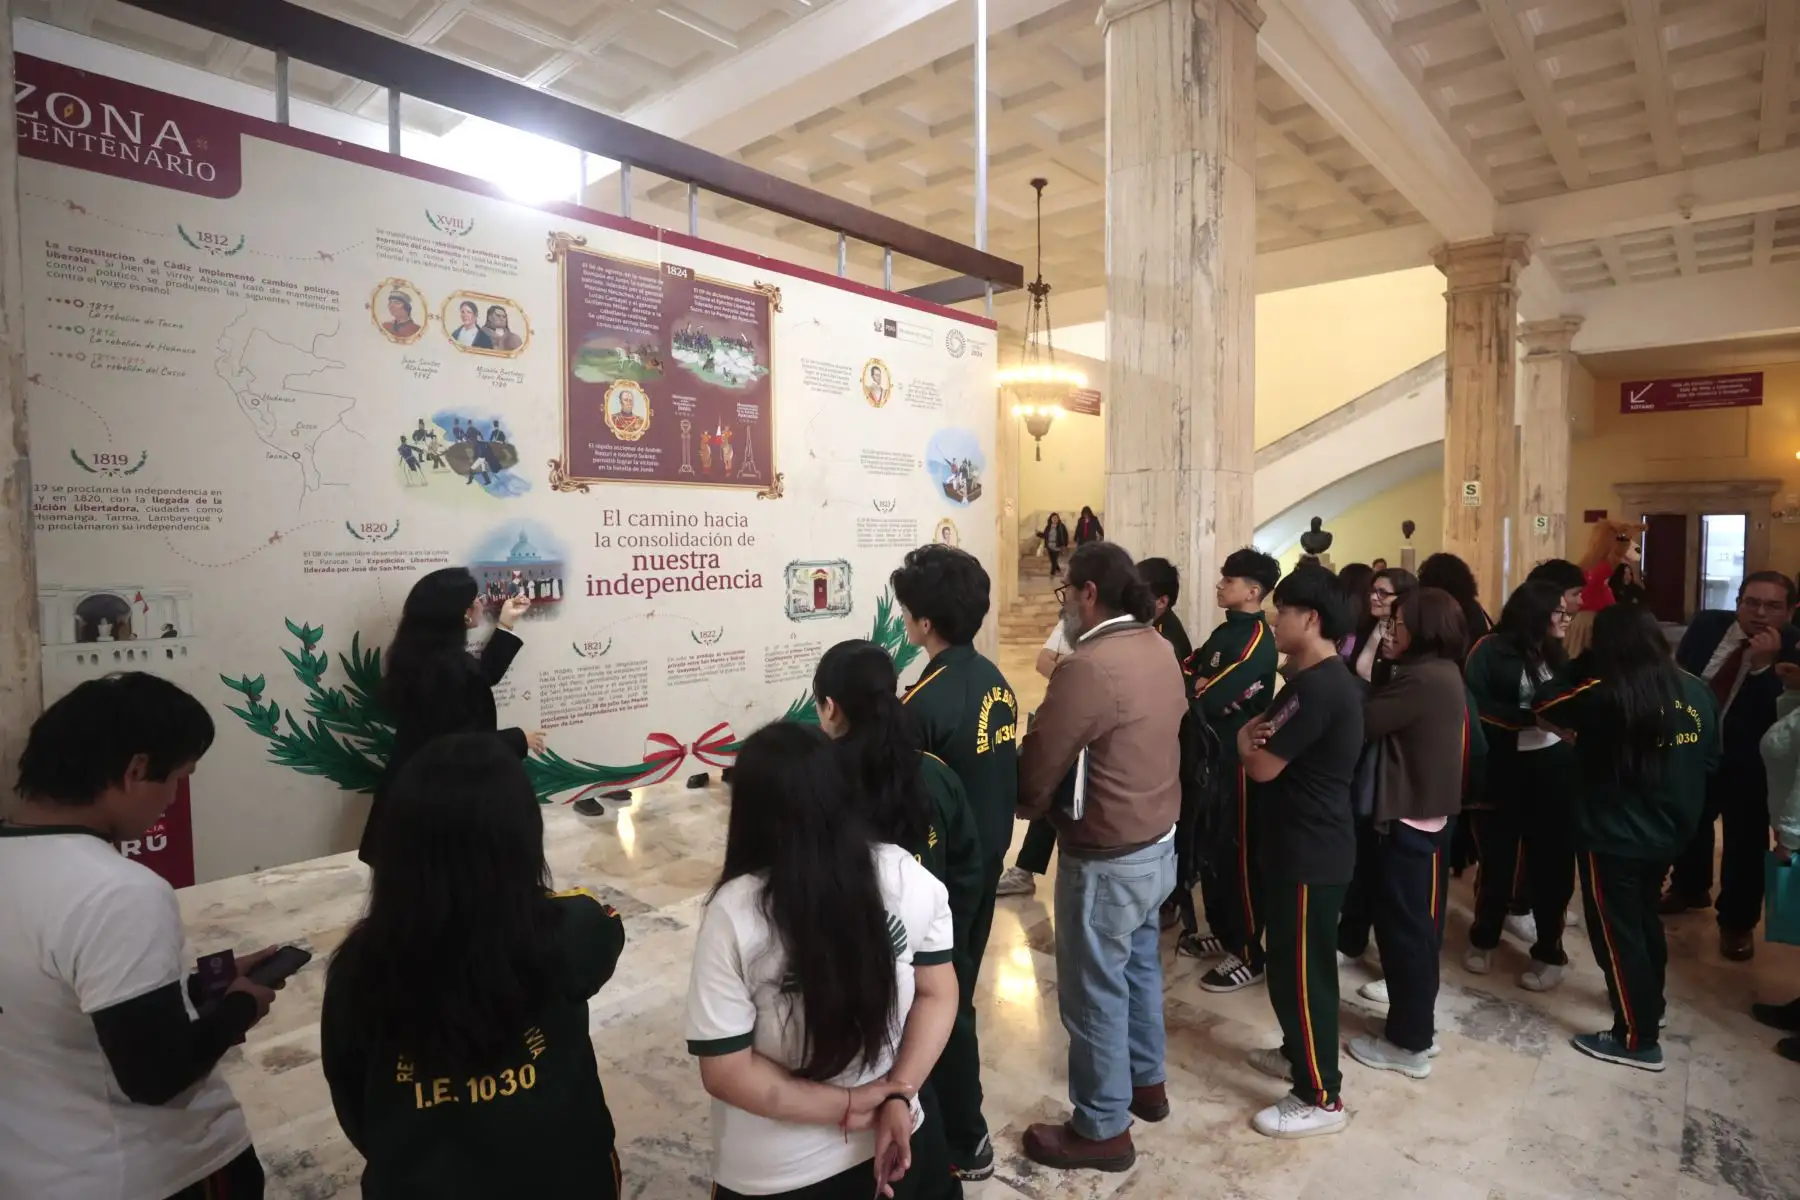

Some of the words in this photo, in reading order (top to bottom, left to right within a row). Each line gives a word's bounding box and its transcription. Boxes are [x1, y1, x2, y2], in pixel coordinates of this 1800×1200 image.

[16, 81, 191, 156] ZONA
[17, 118, 215, 181] CENTENARIO
[436, 215, 464, 229] XVIII
[196, 232, 229, 246] 1812
[46, 241, 59, 250] La
[144, 257, 156, 266] de
[164, 260, 192, 271] Cádiz
[199, 267, 255, 283] implementó
[262, 277, 298, 289] cambios
[666, 265, 688, 278] 1824
[47, 271, 84, 282] contra
[100, 279, 126, 290] yugo
[47, 262, 87, 274] control
[166, 280, 219, 295] produjeron
[227, 288, 239, 297] las
[246, 292, 290, 306] siguientes
[105, 260, 114, 268] Si
[121, 262, 143, 273] bien
[166, 271, 194, 282] virrey
[200, 275, 236, 287] Abascal
[270, 286, 281, 294] de
[286, 290, 326, 302] mantener
[91, 302, 114, 311] 1811
[89, 310, 100, 318] La
[158, 319, 183, 329] Tacna
[90, 335, 102, 344] La
[157, 343, 196, 354] Huánuco
[90, 360, 102, 369] La
[161, 368, 186, 377] Cusco
[93, 454, 128, 465] 1819
[135, 487, 208, 496] independencia
[1466, 484, 1476, 495] S
[74, 495, 103, 503] 1820,
[152, 496, 189, 505] llegada
[74, 504, 139, 513] Libertadora,
[149, 514, 211, 523] Lambayeque
[602, 510, 621, 527] El
[628, 510, 698, 527] camino
[704, 512, 748, 528] hacia
[1537, 517, 1545, 527] S
[48, 522, 119, 531] proclamaron
[361, 524, 388, 532] 1820
[595, 532, 611, 548] la
[618, 532, 732, 548] consolidación
[737, 532, 755, 547] de
[632, 551, 720, 571] nuestra
[586, 569, 763, 600] independencia
[700, 630, 716, 639] 1822
[584, 642, 602, 651] 1821
[1676, 732, 1698, 746] 1030
[415, 1078, 460, 1109] I.E.
[466, 1063, 536, 1103] 1030
